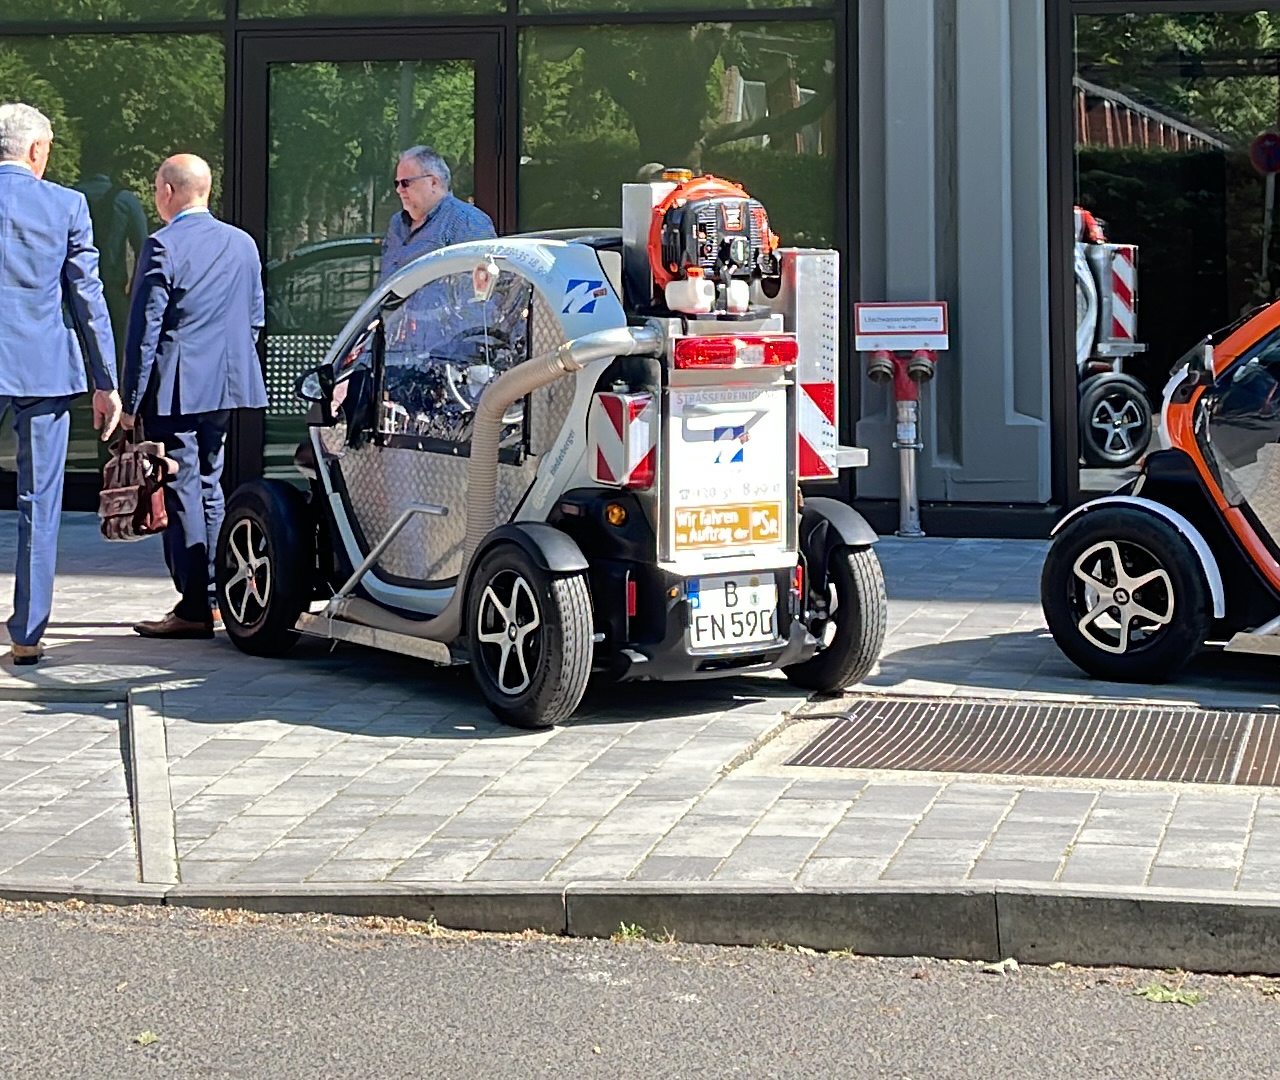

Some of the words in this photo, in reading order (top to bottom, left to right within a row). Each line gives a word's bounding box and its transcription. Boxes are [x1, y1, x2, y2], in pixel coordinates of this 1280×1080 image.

[677, 387, 775, 405] STRASSENREINIG
[676, 511, 698, 527] Wir
[699, 509, 740, 526] fahren
[689, 526, 733, 544] Auftrag
[724, 581, 738, 607] B
[695, 614, 726, 641] FN
[730, 609, 772, 637] 590
